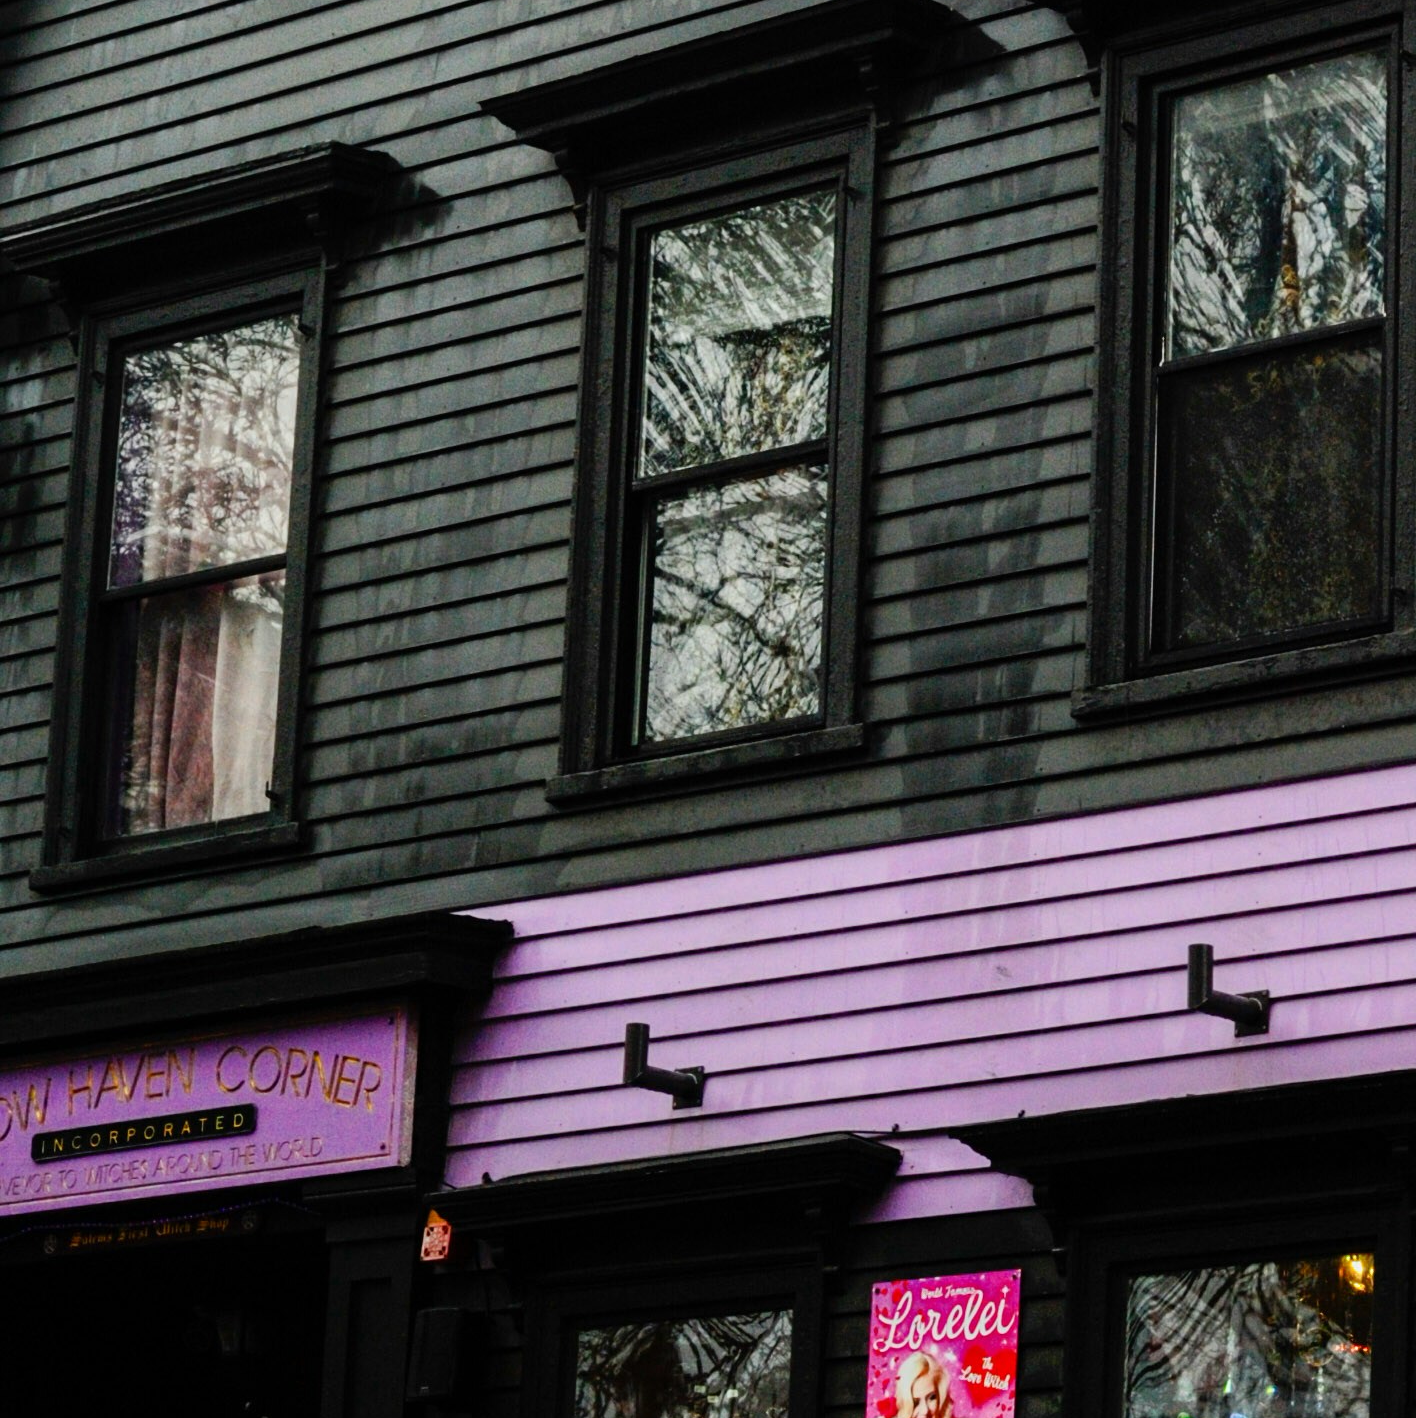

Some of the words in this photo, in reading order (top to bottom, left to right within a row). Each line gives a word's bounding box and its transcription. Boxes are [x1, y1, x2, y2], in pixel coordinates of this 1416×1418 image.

[67, 1049, 196, 1115] HAVEN
[216, 1045, 382, 1110] CORNER
[41, 1113, 245, 1154] INCORPORATED
[58, 1169, 77, 1191] TO
[84, 1159, 147, 1183] WITCHES
[229, 1144, 256, 1167] THE
[261, 1137, 323, 1163] WORLD
[873, 1284, 1016, 1353] Lorelei
